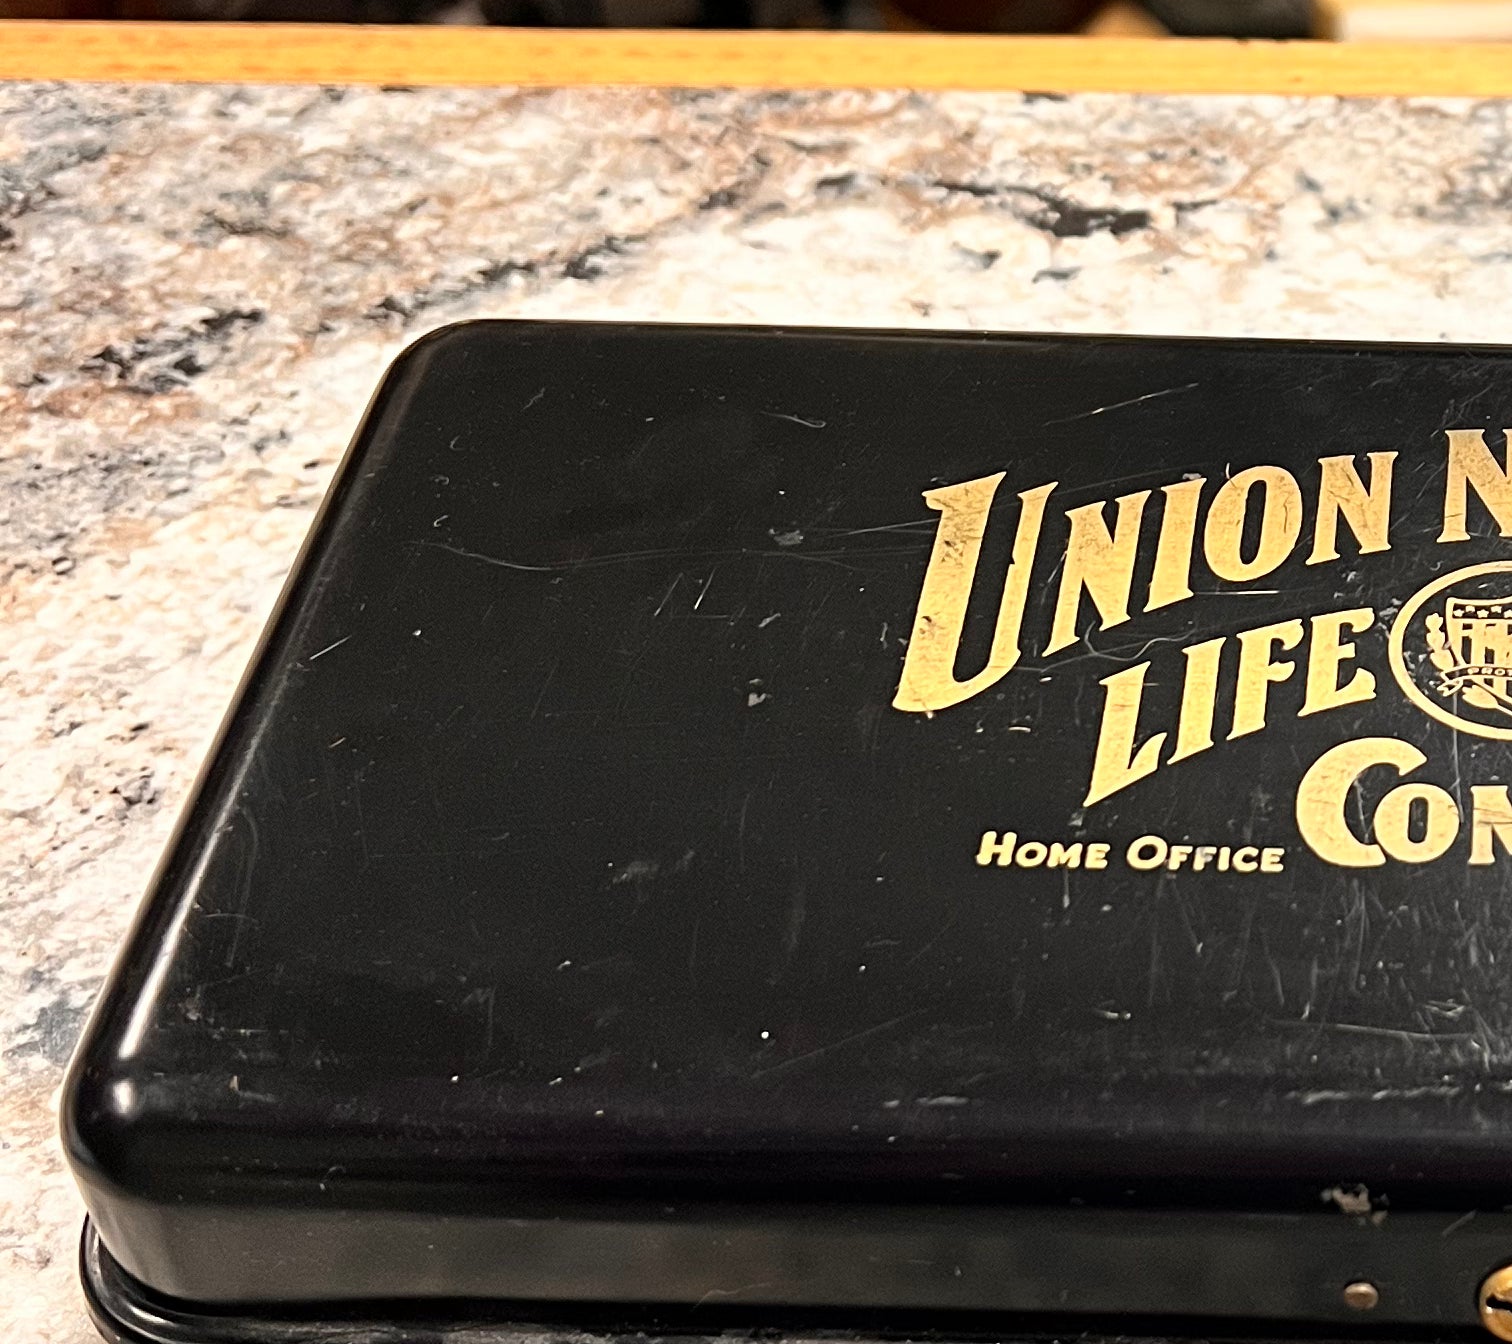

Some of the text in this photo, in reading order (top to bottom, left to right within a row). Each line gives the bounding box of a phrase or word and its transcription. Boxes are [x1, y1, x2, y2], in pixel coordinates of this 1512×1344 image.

[892, 451, 1399, 713] UNION
[1083, 607, 1378, 808] LIFE
[976, 830, 1286, 873] HOME OFFICE
